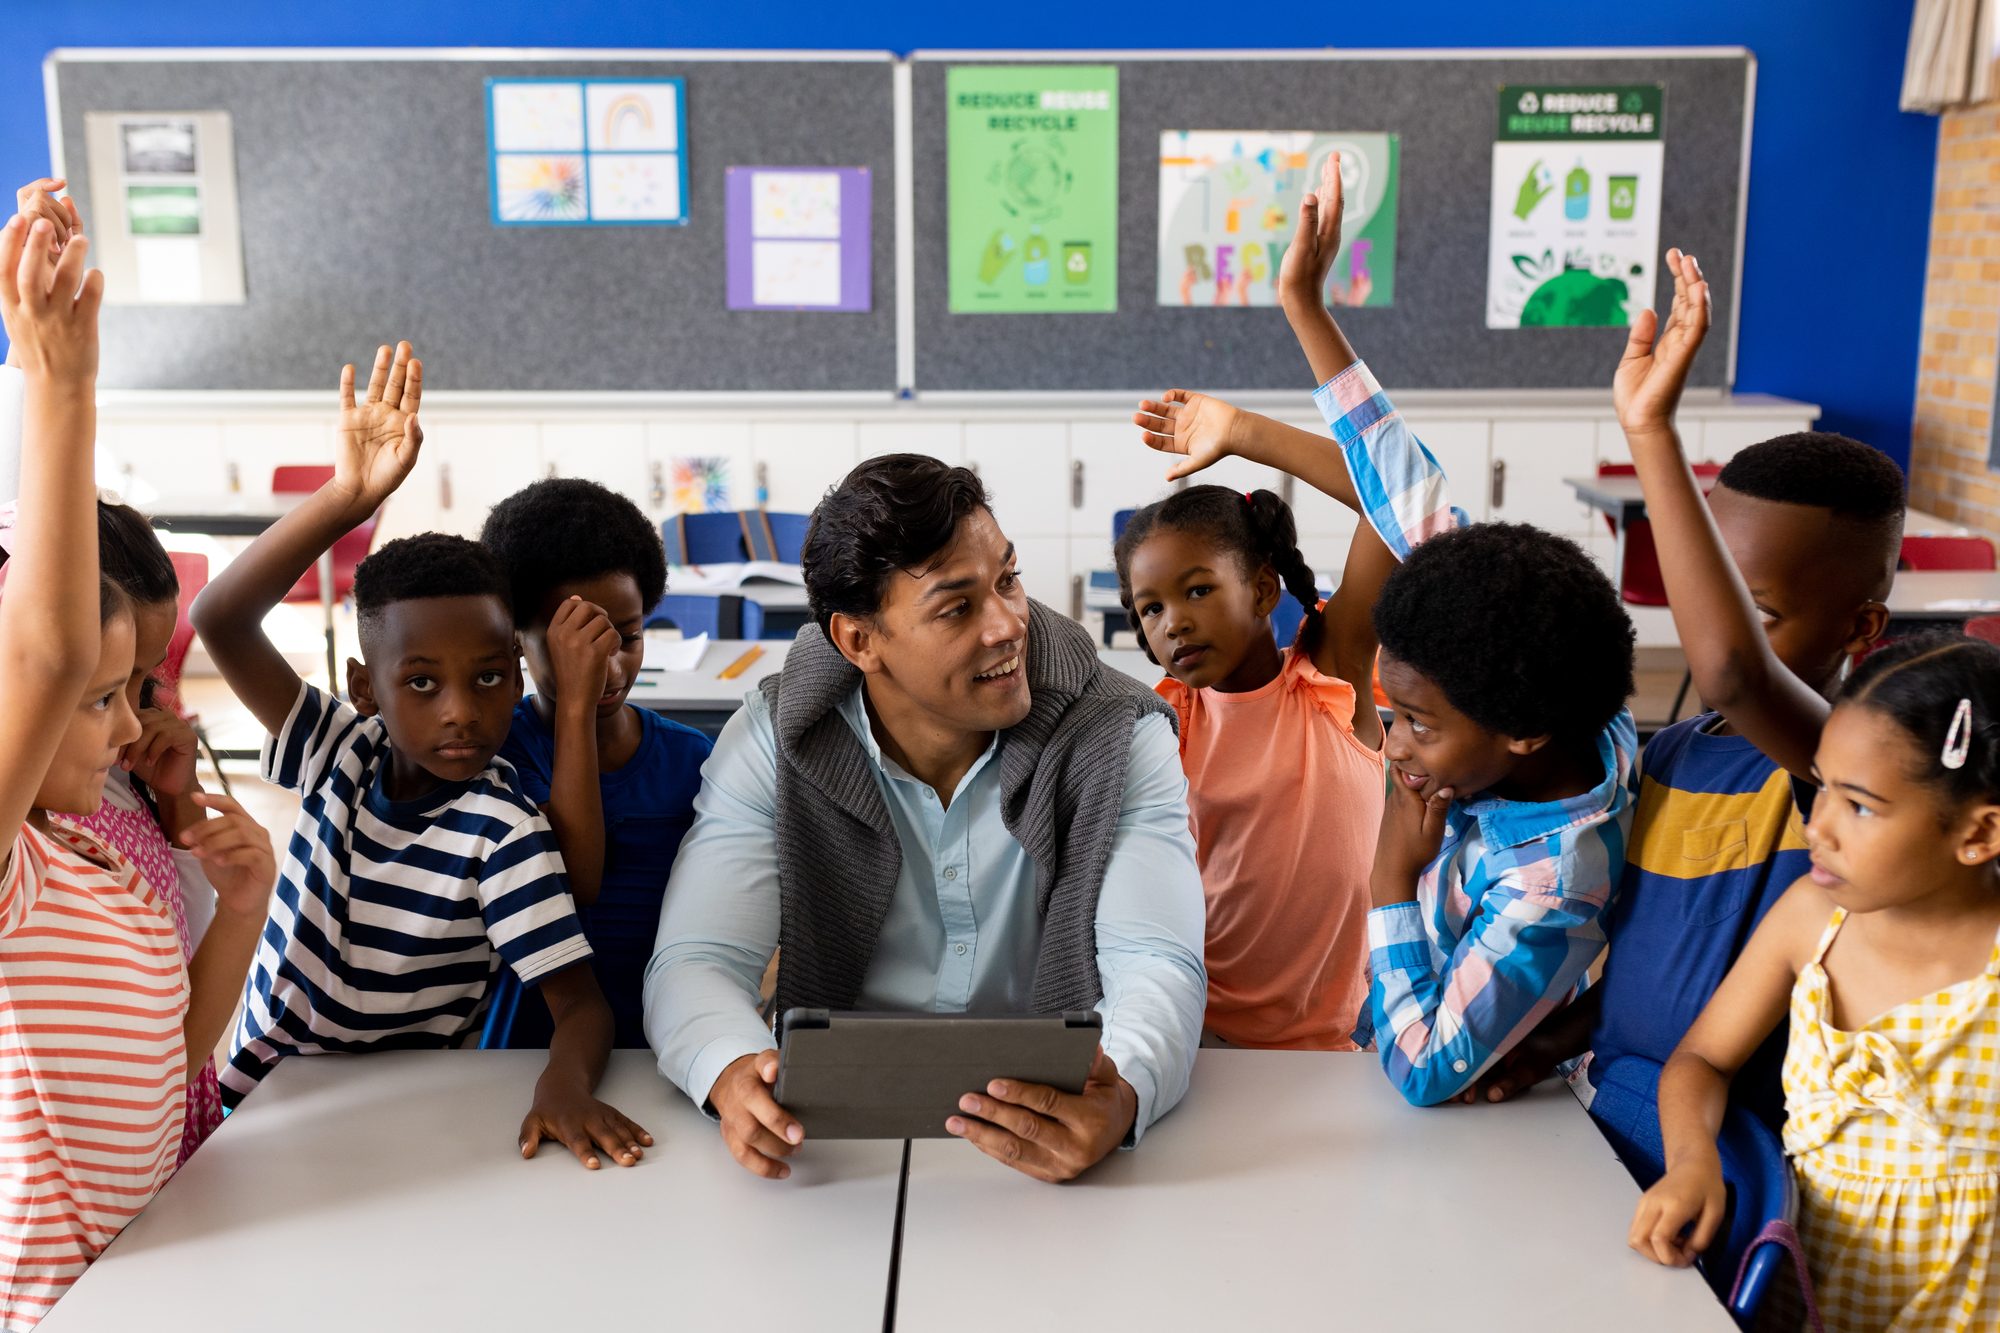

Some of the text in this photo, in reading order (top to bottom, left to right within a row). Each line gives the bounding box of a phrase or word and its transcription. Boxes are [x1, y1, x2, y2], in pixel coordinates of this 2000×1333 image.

[957, 91, 1036, 109] REDUCE
[1542, 92, 1618, 113] REDUCE
[987, 114, 1077, 131] RECYCLE
[1571, 113, 1654, 133] RECYCLE
[1183, 239, 1373, 286] RECYE
